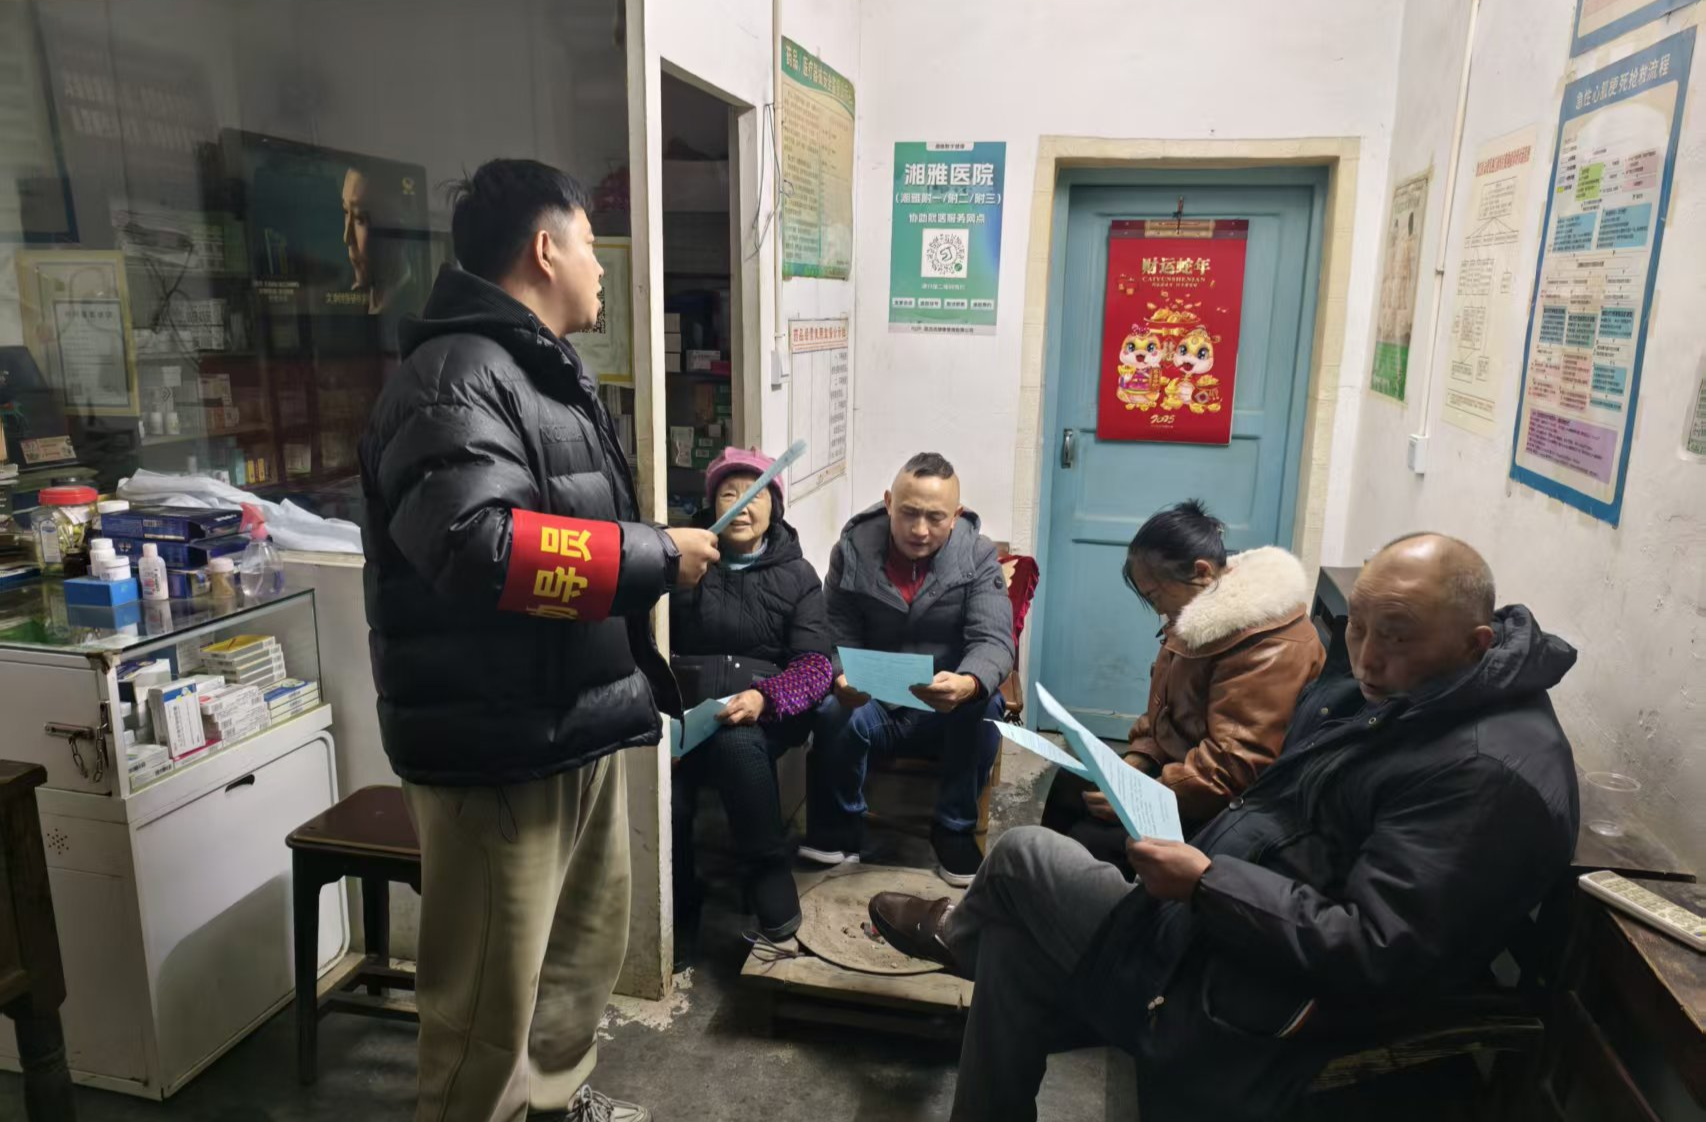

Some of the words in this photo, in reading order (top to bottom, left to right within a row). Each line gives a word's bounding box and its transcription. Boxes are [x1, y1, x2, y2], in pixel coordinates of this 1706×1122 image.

[1576, 53, 1671, 110] 急性心肌梗死抢救流程
[905, 163, 994, 185] 湘雅医院
[1142, 257, 1210, 275] 财运蛇年
[1151, 414, 1176, 424] 2025
